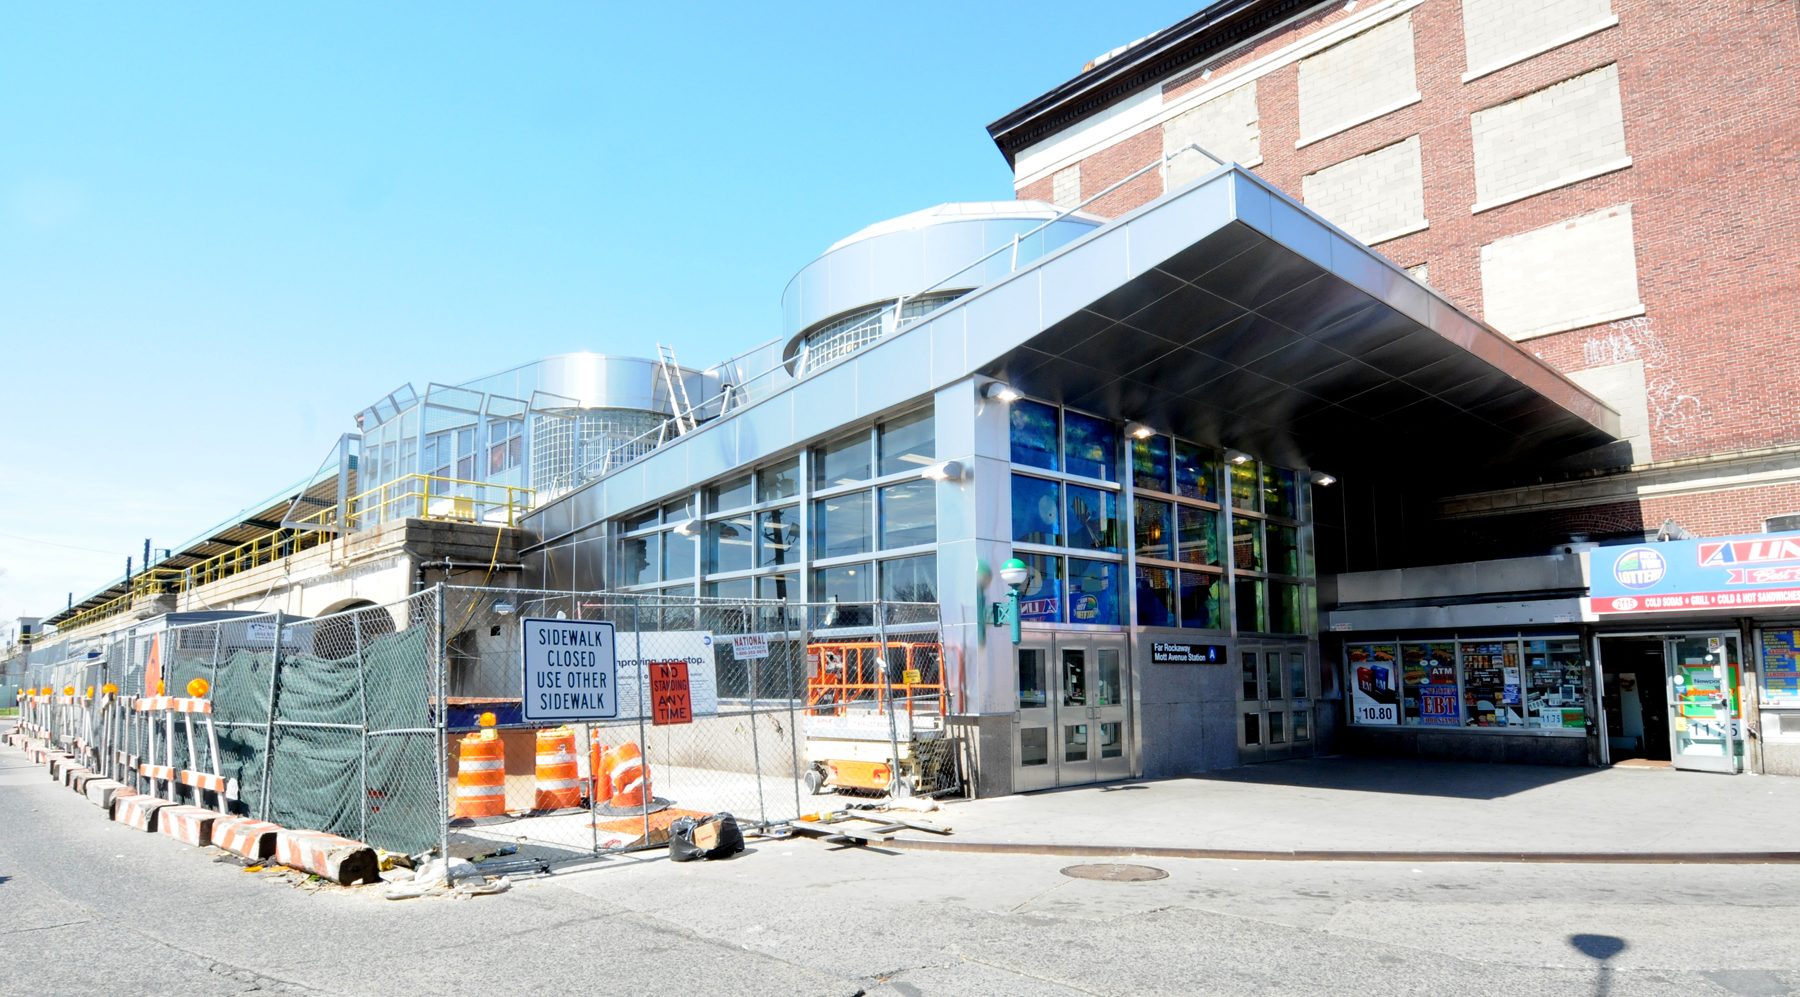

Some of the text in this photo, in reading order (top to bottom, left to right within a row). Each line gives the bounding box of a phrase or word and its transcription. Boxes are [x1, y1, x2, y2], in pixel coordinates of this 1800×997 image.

[1704, 541, 1737, 565] A
[1617, 600, 1634, 608] 2115
[1645, 598, 1662, 607] COLD
[1663, 596, 1684, 606] SODAS
[1691, 595, 1709, 605] GRILL
[1717, 593, 1735, 604] COLD
[1743, 592, 1756, 602] HOT
[539, 629, 602, 647] SIDEWALK
[734, 635, 765, 647] NATIONAL
[1154, 643, 1190, 653] Far Rockaway
[547, 650, 596, 667] CLOSED
[1154, 653, 1206, 661] Mott Avenue Station
[660, 667, 678, 678] NO
[1432, 667, 1453, 675] ATM
[537, 671, 607, 688] USE OTHER
[653, 680, 687, 692] STANDING
[540, 693, 604, 710] SIDEWALK
[658, 694, 685, 706] ANY
[1422, 695, 1457, 715] EBT
[659, 707, 686, 720] TIME
